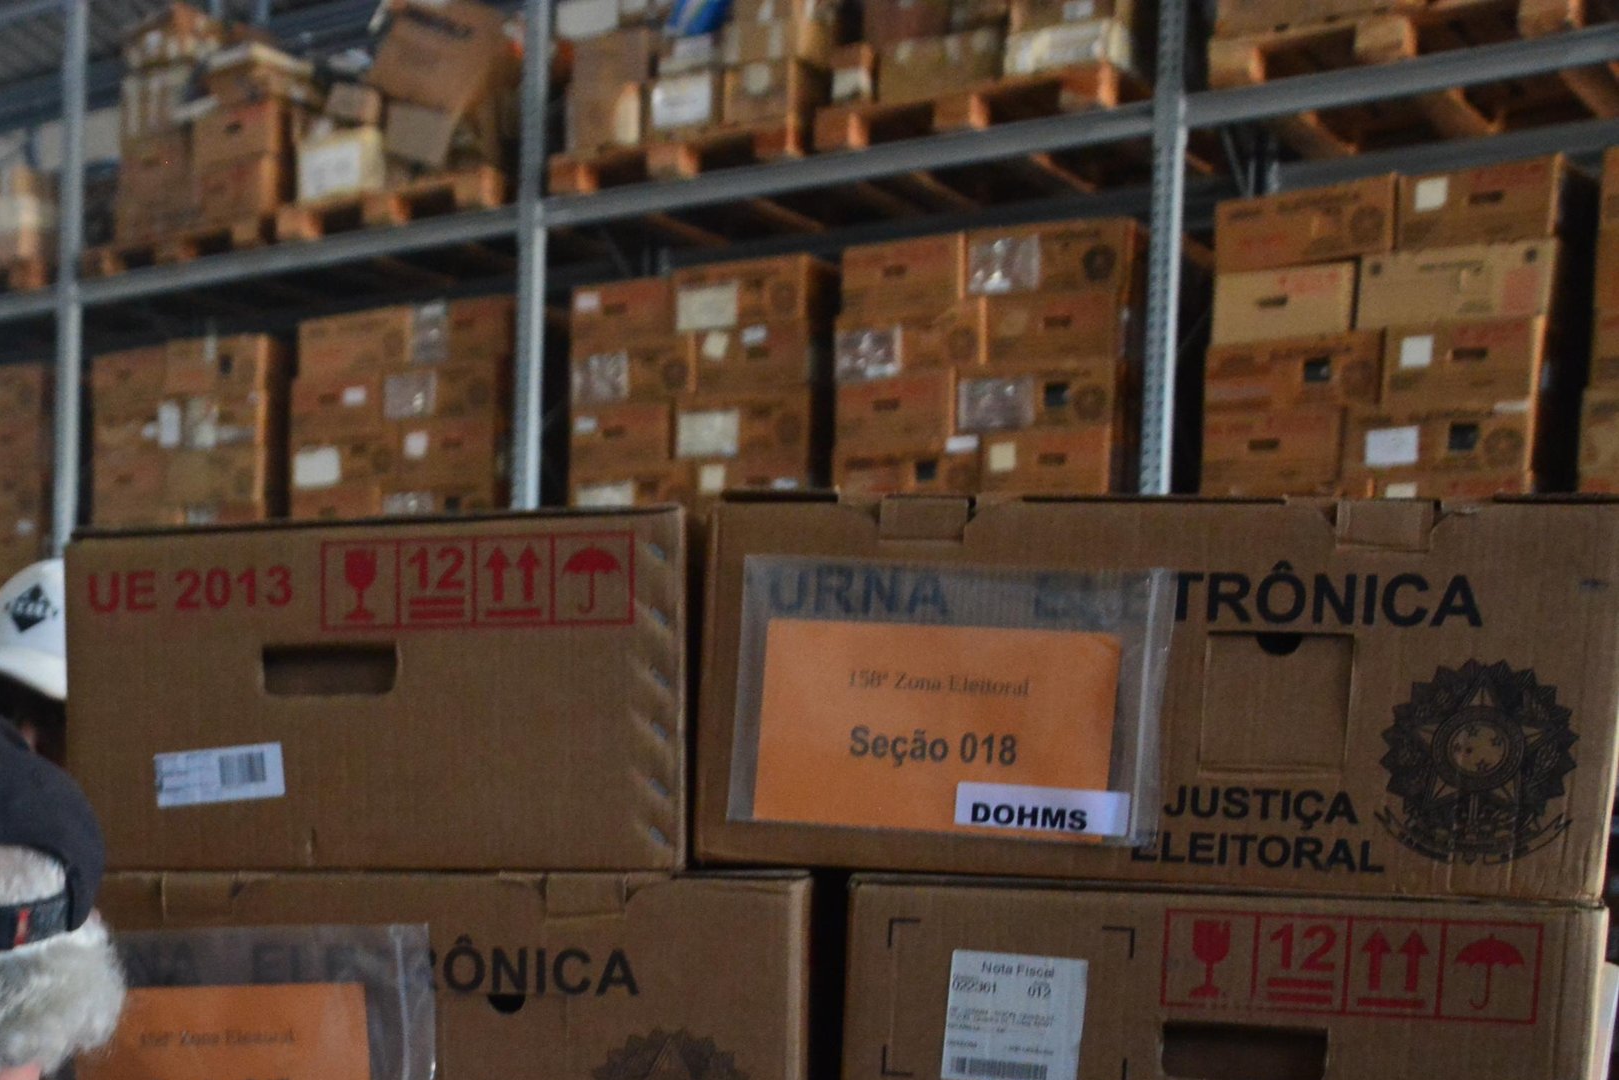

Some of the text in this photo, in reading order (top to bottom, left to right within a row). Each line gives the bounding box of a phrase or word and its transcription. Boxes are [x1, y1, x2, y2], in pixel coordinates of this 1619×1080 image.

[87, 564, 295, 614] UE 2013
[406, 546, 466, 591] 12
[769, 563, 949, 618] URNA
[895, 673, 942, 693] Zona
[849, 724, 1019, 768] Seção 018
[970, 802, 1088, 832] DOHMS
[1163, 784, 1359, 830] JUSTIÇA
[981, 960, 1056, 978] Nota Fiscal
[1270, 923, 1339, 973] 12
